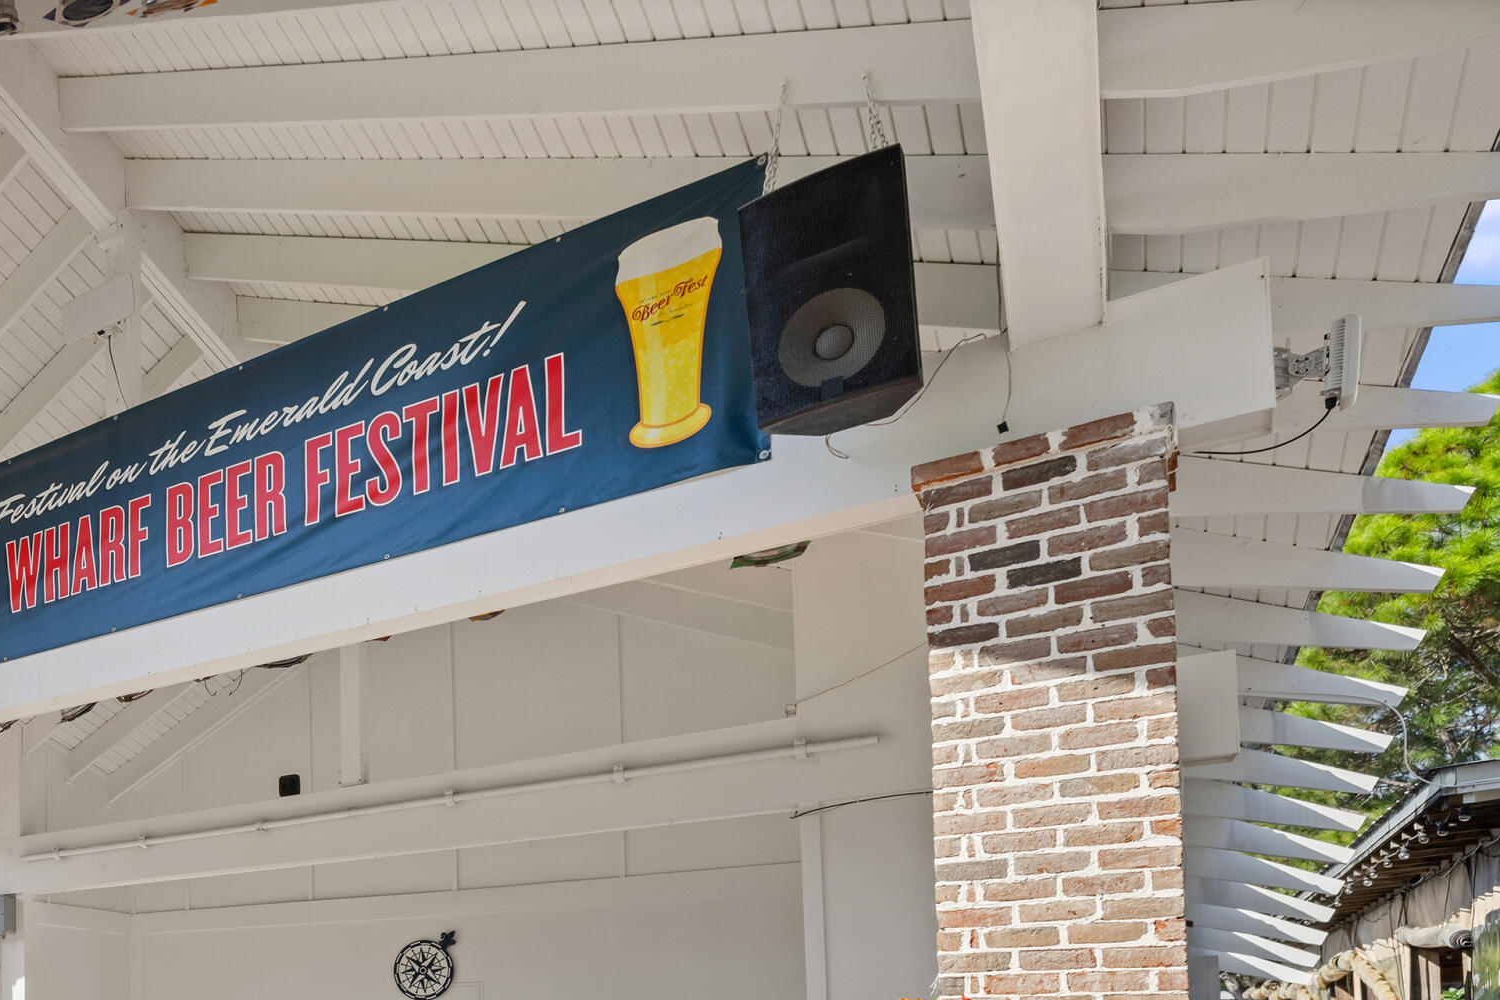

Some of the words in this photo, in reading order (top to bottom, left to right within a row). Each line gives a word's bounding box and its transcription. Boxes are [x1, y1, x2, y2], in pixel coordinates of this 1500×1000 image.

[632, 294, 673, 322] Beer
[674, 275, 708, 298] Fest
[5, 493, 153, 614] WHARF
[165, 450, 288, 569] BEER
[304, 351, 584, 527] FESTIVAL
[105, 456, 143, 489] on
[147, 430, 207, 476] the
[204, 357, 375, 457] Emerald
[369, 299, 528, 397] Coast!
